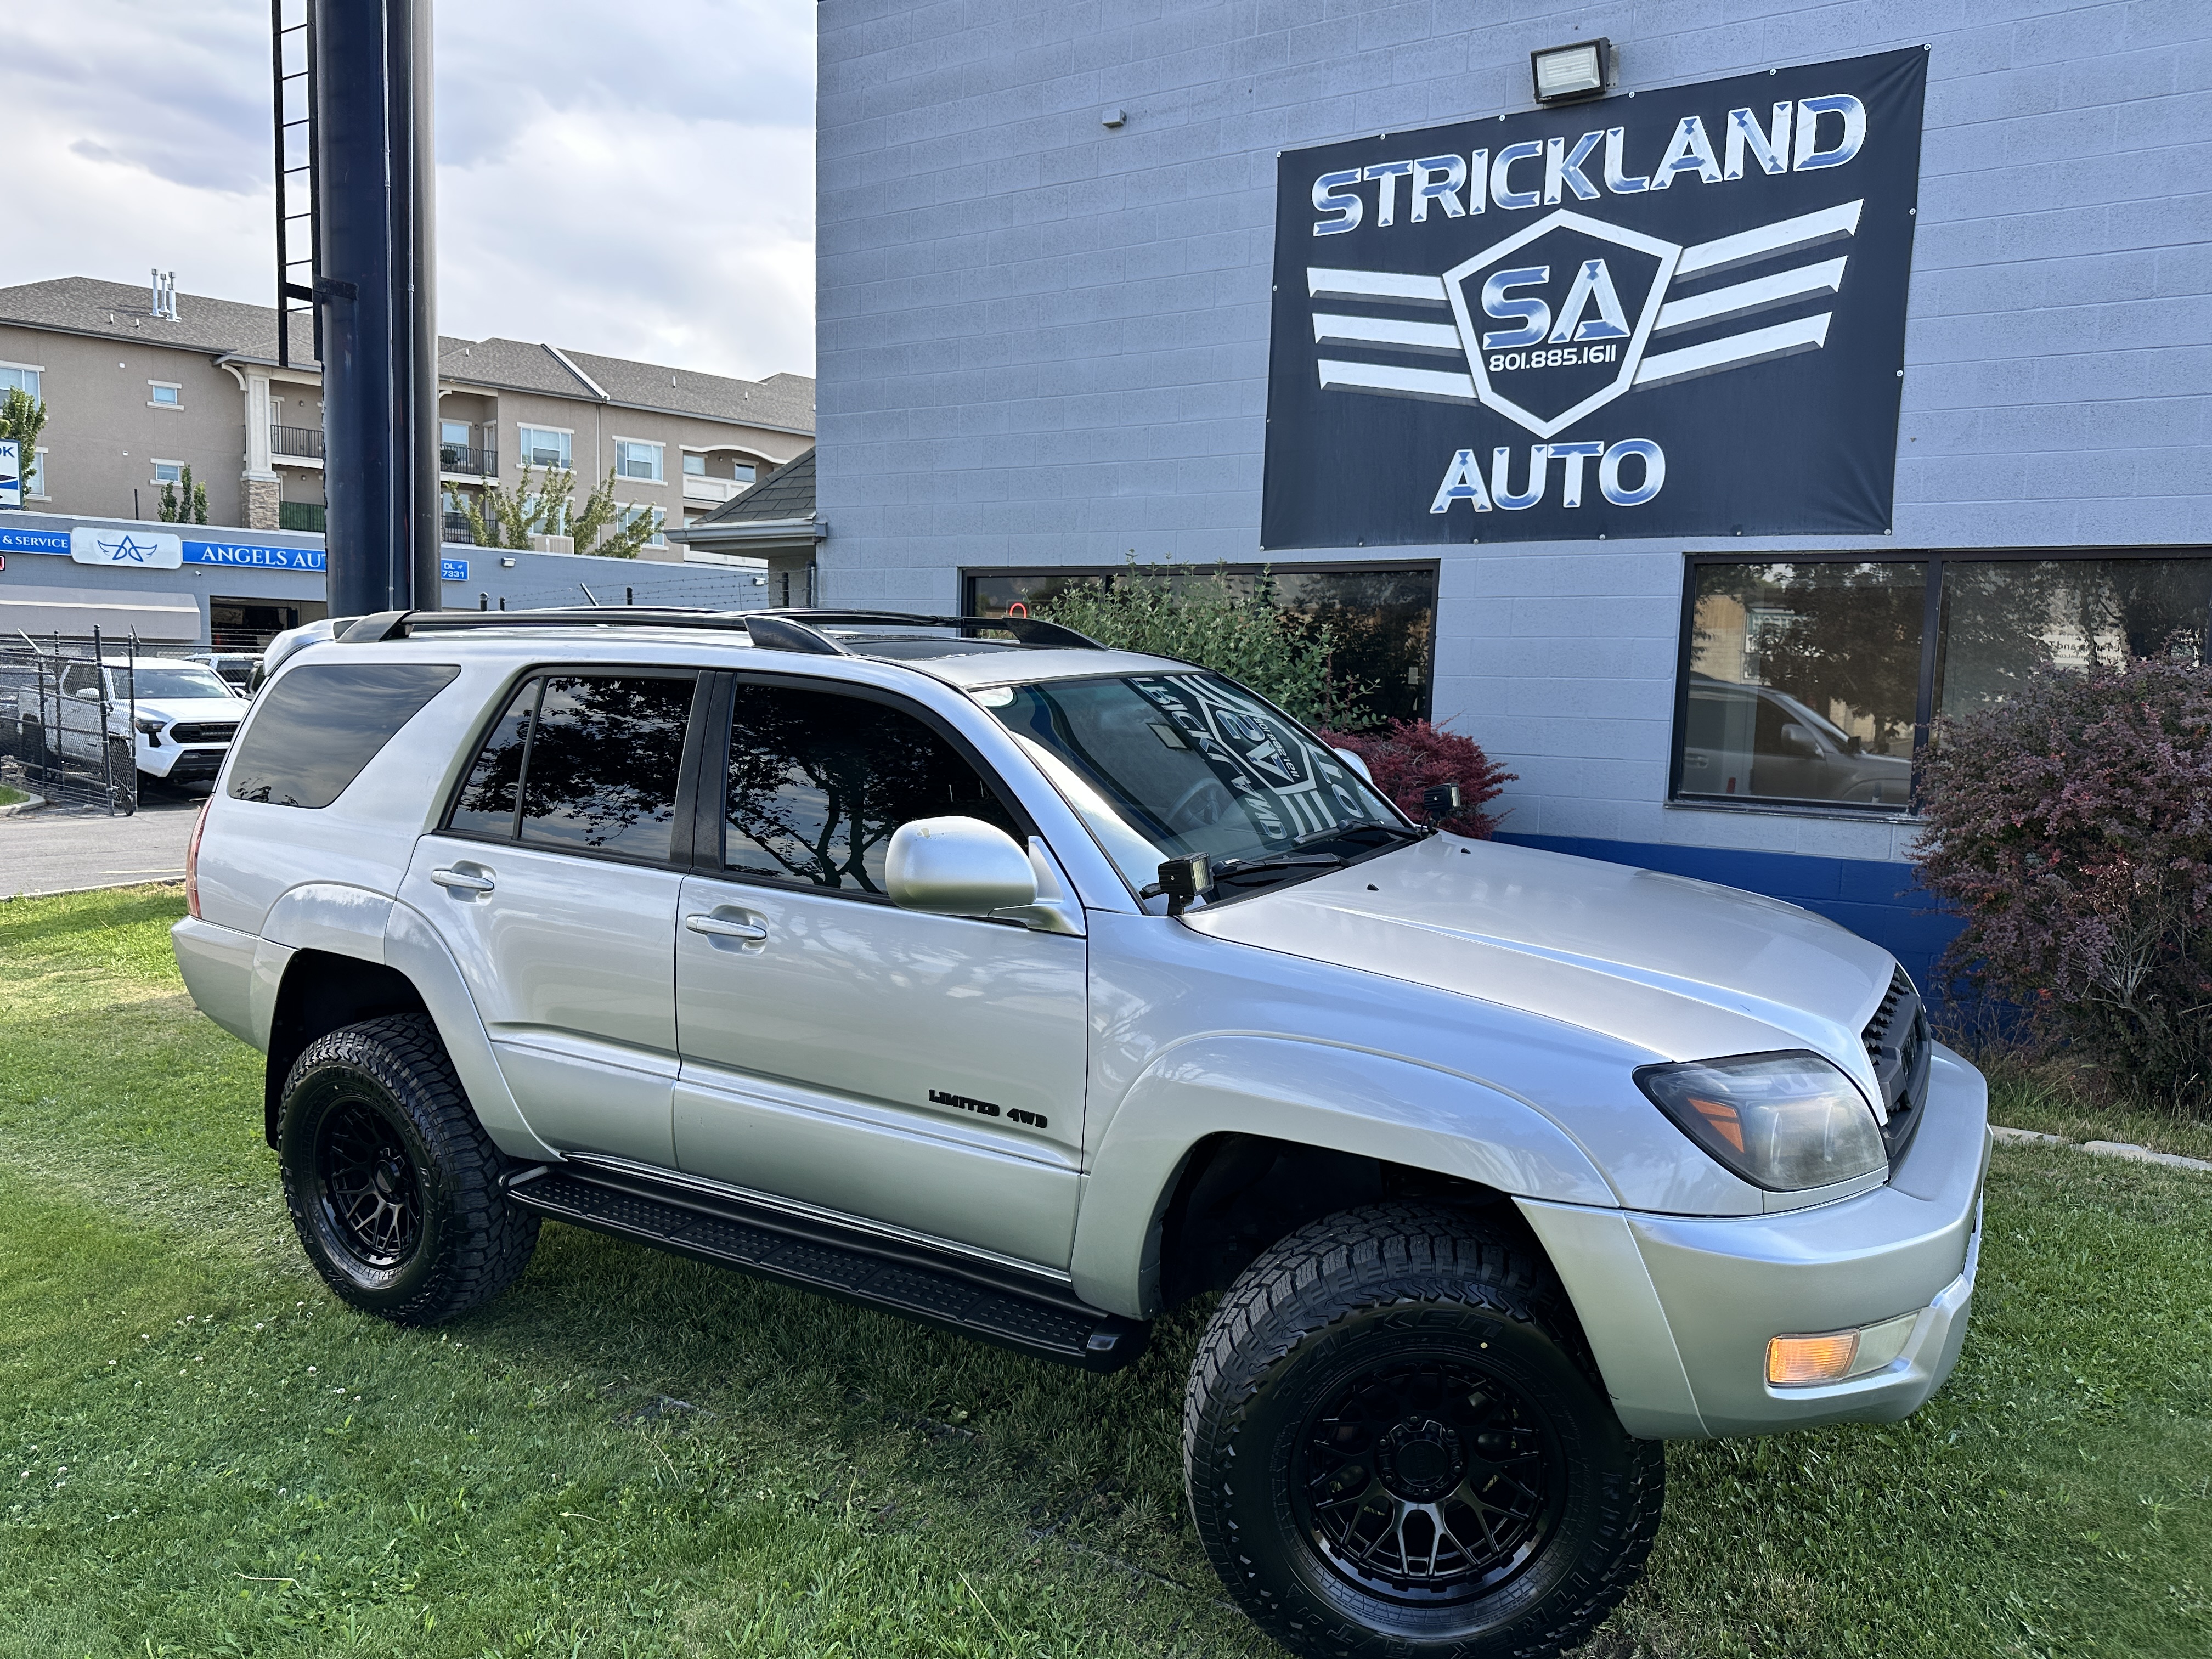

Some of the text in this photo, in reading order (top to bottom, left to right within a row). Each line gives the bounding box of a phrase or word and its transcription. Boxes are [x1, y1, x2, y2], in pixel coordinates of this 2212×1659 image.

[1311, 93, 1867, 236] STRICKLAND
[1481, 258, 1631, 351] SA
[1488, 343, 1617, 372] 801.885.1611
[1430, 438, 1666, 514] AUTO
[15, 535, 69, 548] SERVICE
[201, 545, 326, 568] ANGELS AU
[442, 569, 464, 578] 7331
[929, 1089, 1048, 1128] LIMITED 4WD
